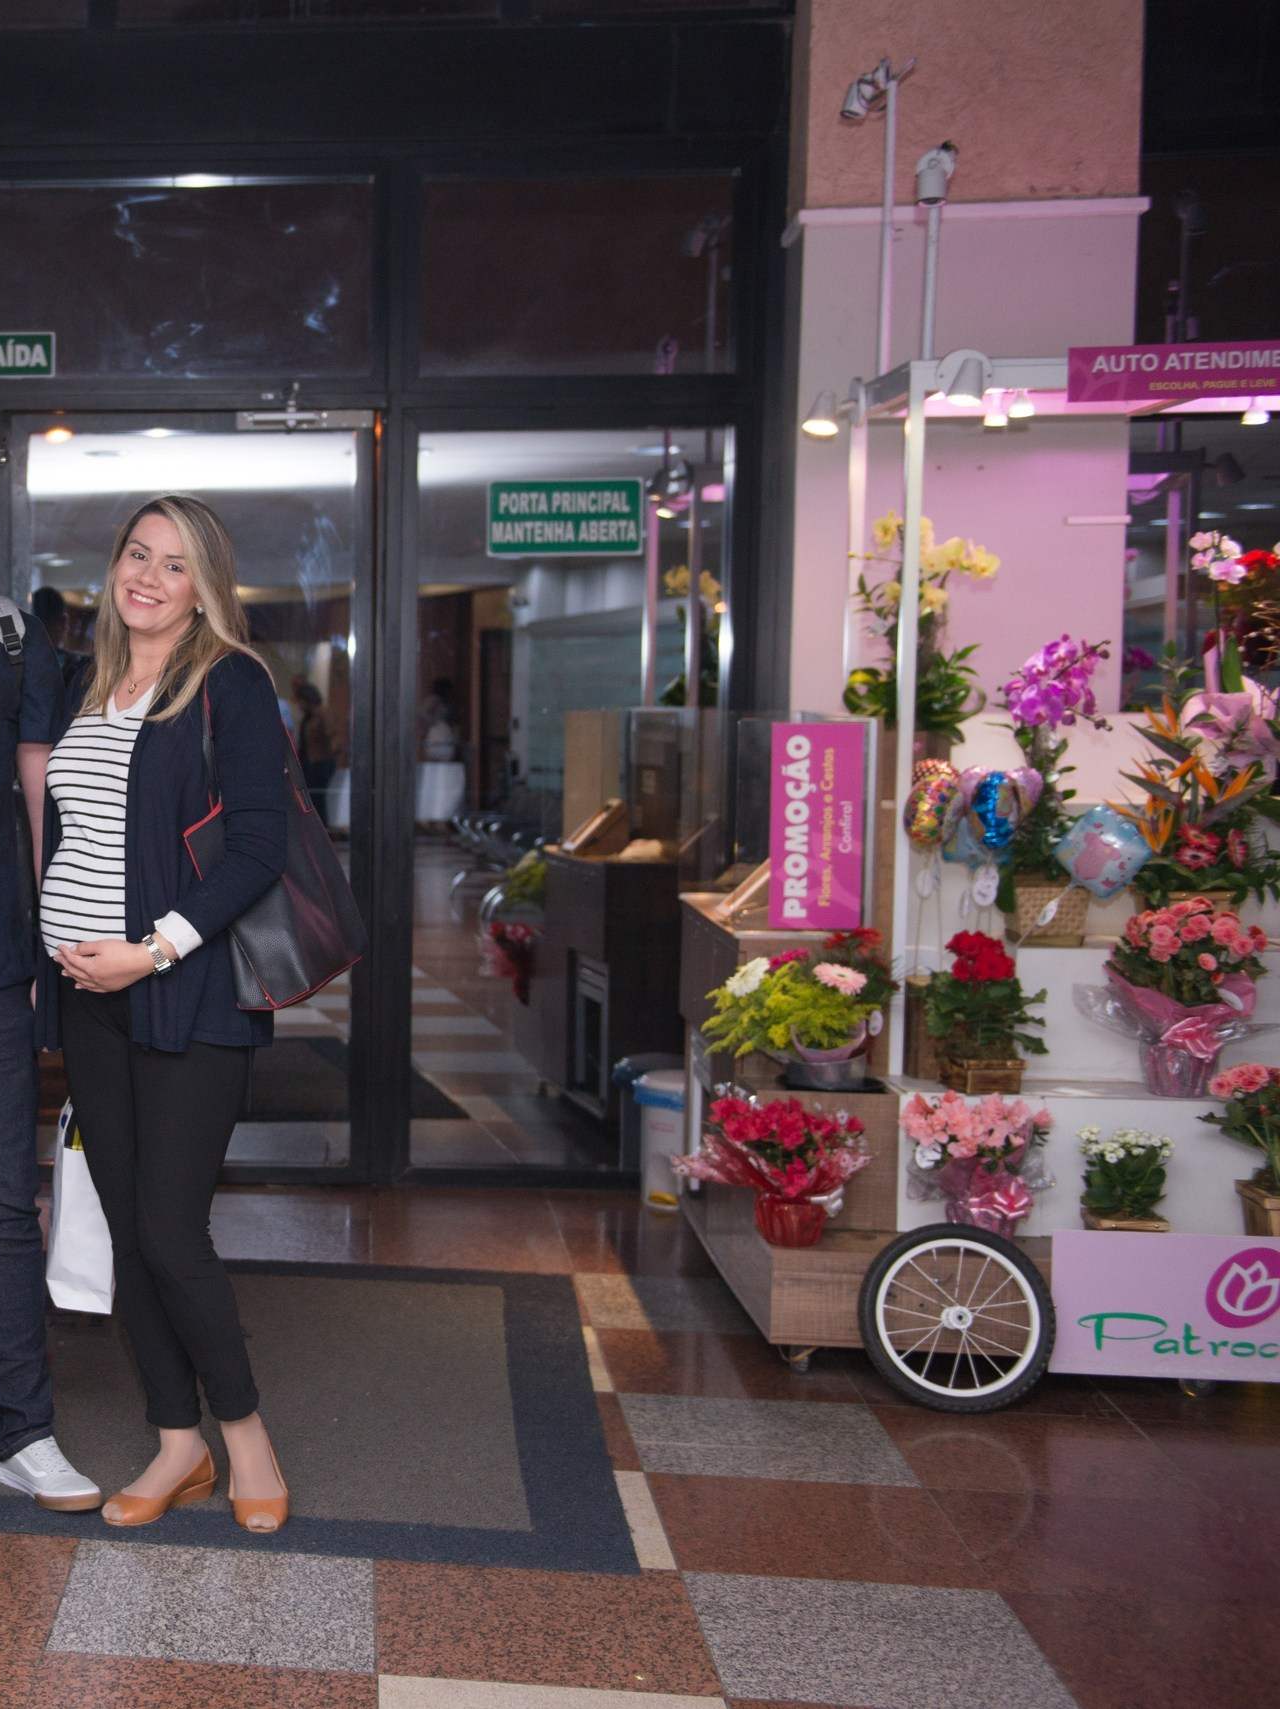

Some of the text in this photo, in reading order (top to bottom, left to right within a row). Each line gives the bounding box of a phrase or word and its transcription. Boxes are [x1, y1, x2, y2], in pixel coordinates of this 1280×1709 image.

[1091, 353, 1159, 374] AUTO
[1203, 380, 1238, 389] PAGUE
[1249, 378, 1277, 388] LEVE
[498, 490, 630, 515] PORTA PRINCIPAL
[491, 520, 637, 544] MANTENHA ABERTA
[820, 747, 835, 791] Cestas
[782, 734, 816, 918] PROMOÇÃO
